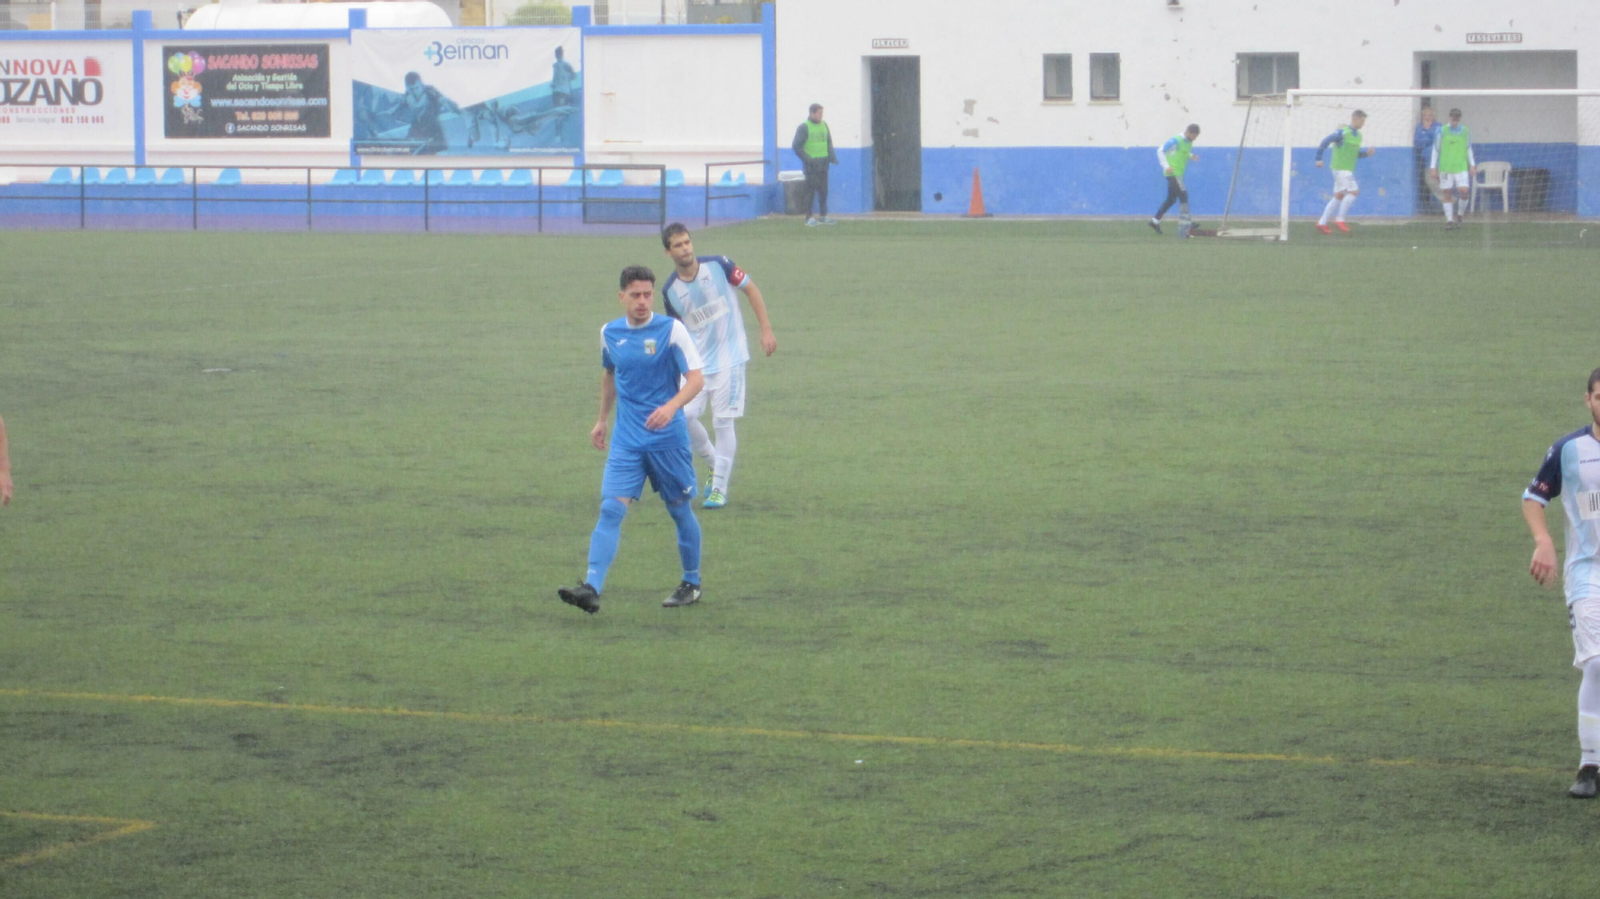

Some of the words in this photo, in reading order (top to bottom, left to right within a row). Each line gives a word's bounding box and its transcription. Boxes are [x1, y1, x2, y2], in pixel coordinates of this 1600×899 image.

[1469, 34, 1520, 42] VESTUARIOS
[208, 54, 259, 69] SACANDO
[261, 54, 319, 69] SONRISAS
[236, 124, 269, 132] SACANDO
[270, 124, 307, 132] SONRISAS
